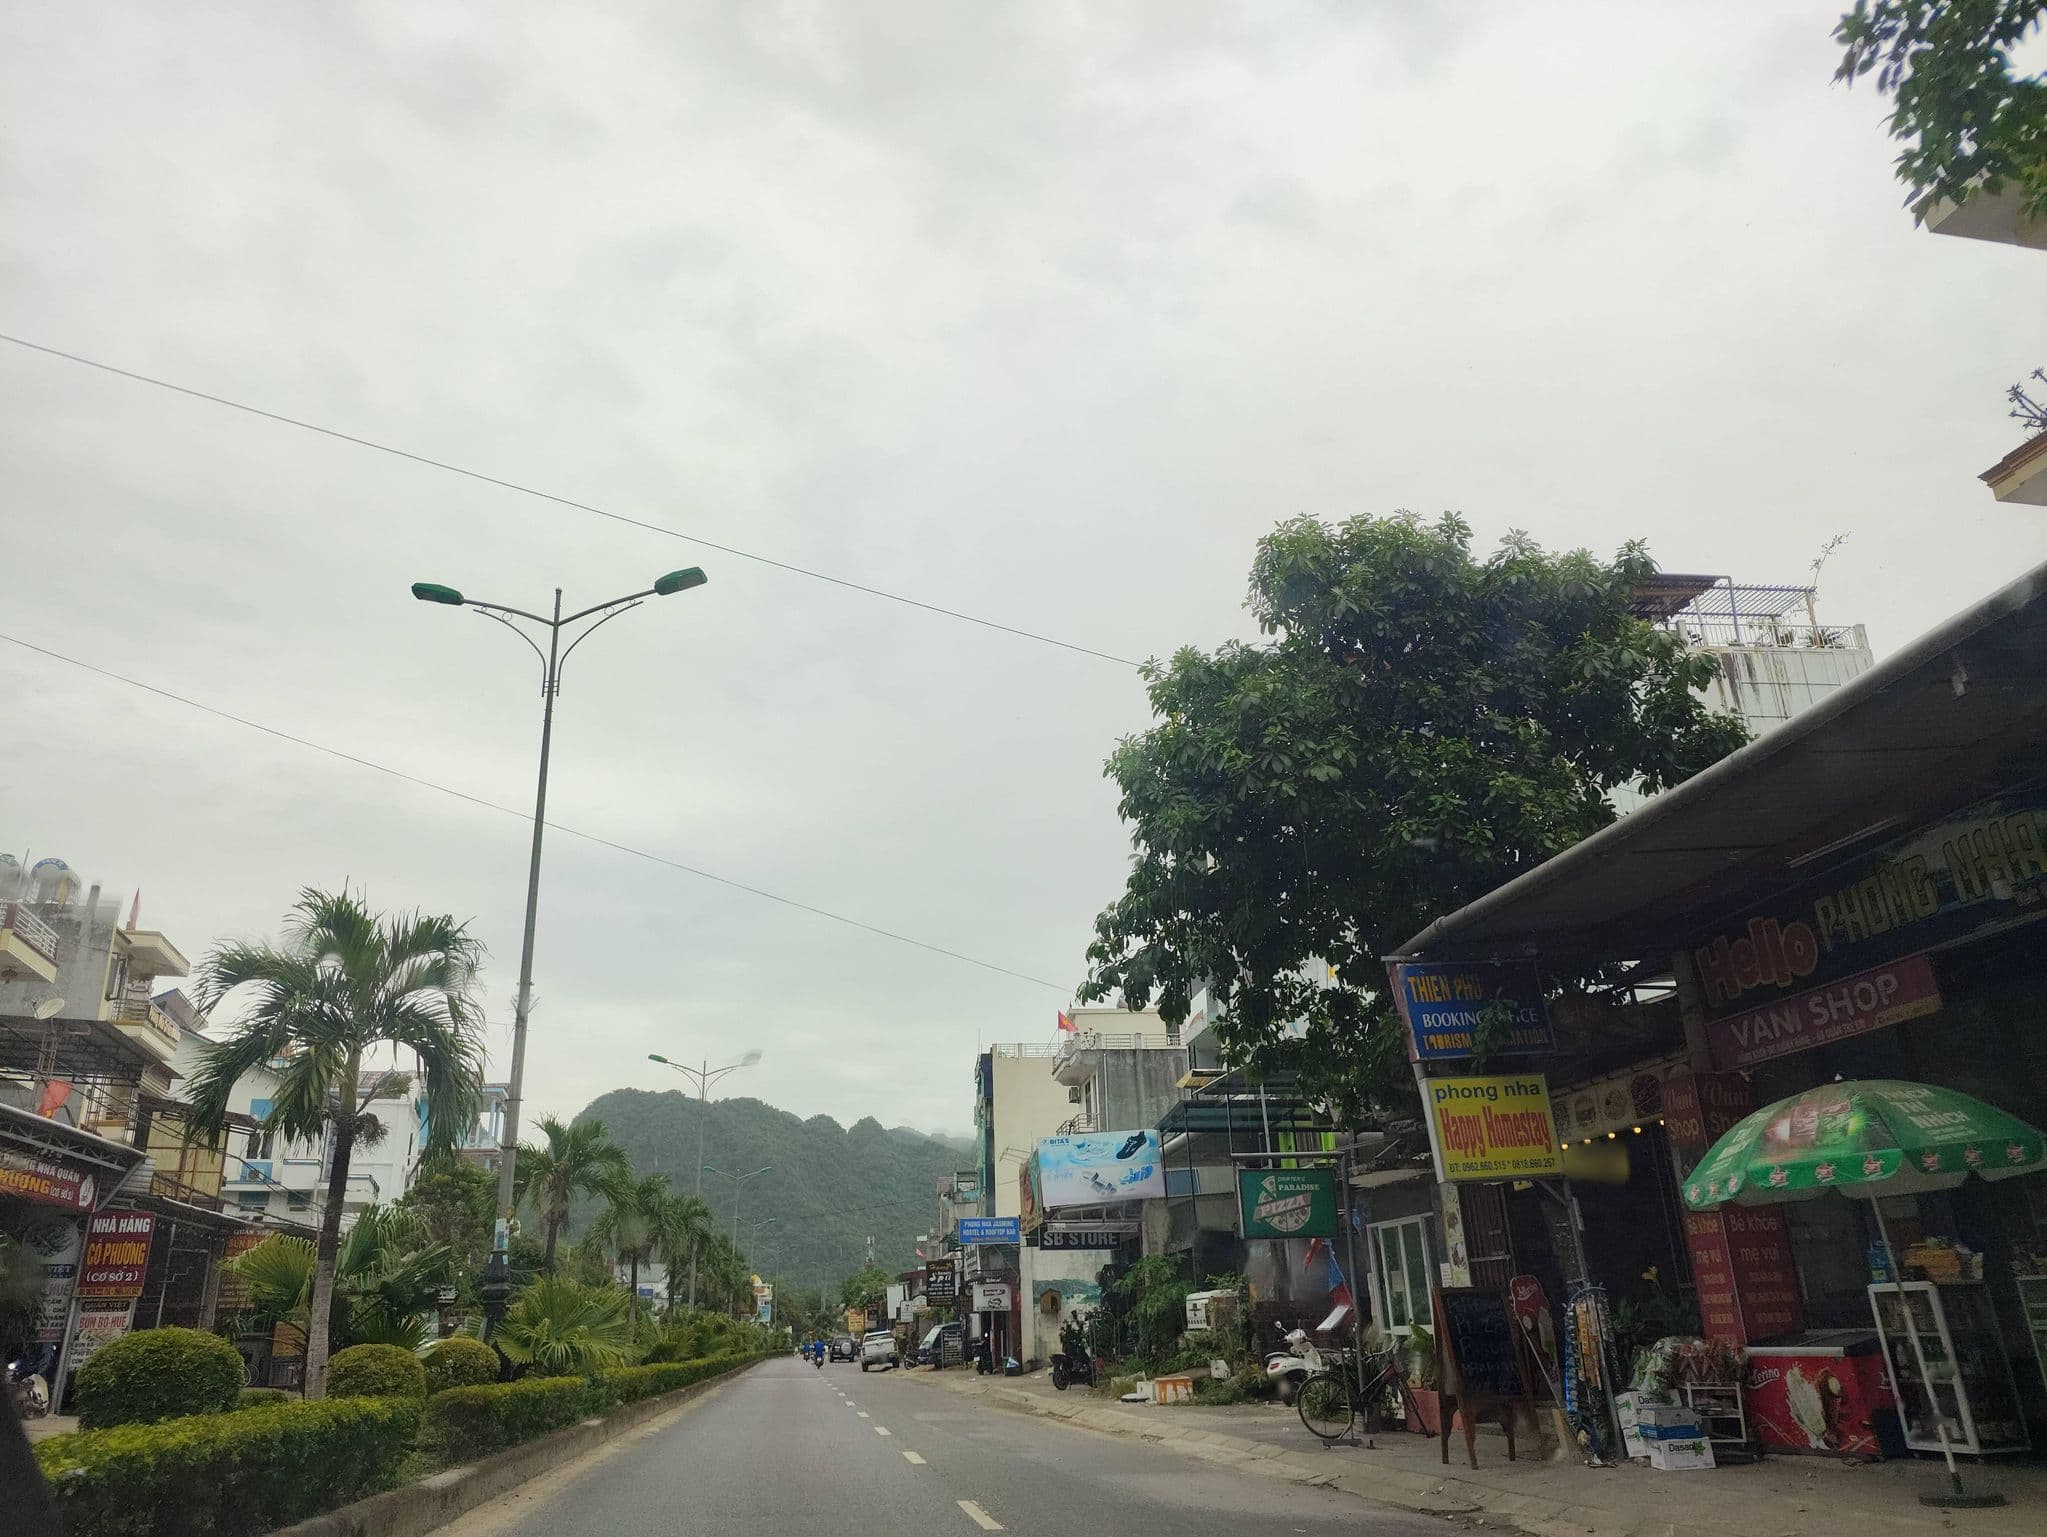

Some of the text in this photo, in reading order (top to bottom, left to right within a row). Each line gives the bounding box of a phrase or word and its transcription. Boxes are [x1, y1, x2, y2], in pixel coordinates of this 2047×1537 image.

[1695, 808, 2047, 1008] Hello PHONG NHA
[1808, 973, 1899, 1026] SHOP
[1435, 1081, 1541, 1102] phong nha
[1439, 1105, 1553, 1158] Happy Homestay
[1262, 1195, 1305, 1217] PIZZA
[92, 1215, 151, 1233] NHÀ HÀNG
[1043, 1232, 1117, 1246] SB STORE
[87, 1238, 147, 1265] CÔ PHƯƠNG
